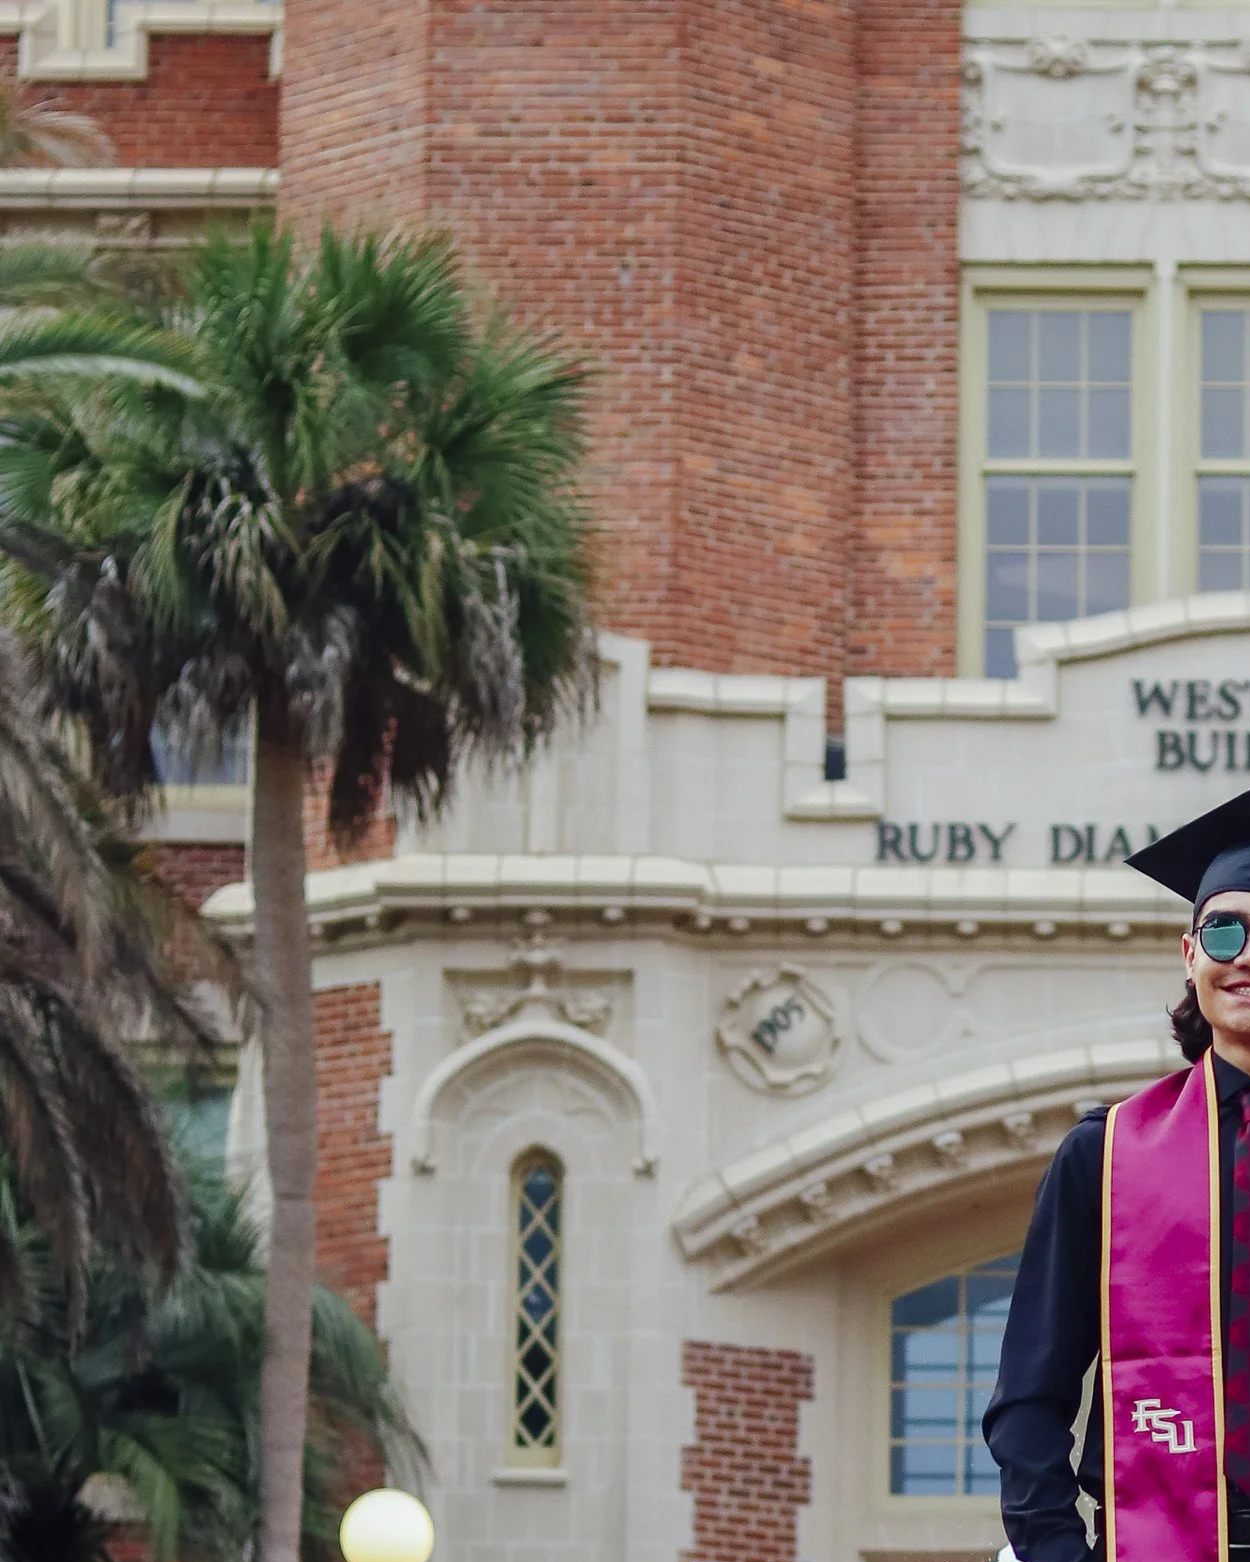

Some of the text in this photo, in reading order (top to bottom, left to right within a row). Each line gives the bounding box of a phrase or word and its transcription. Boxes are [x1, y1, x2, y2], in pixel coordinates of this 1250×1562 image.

[875, 821, 1017, 864] RUBY
[751, 995, 806, 1055] 1905
[1130, 1398, 1198, 1454] FSU
